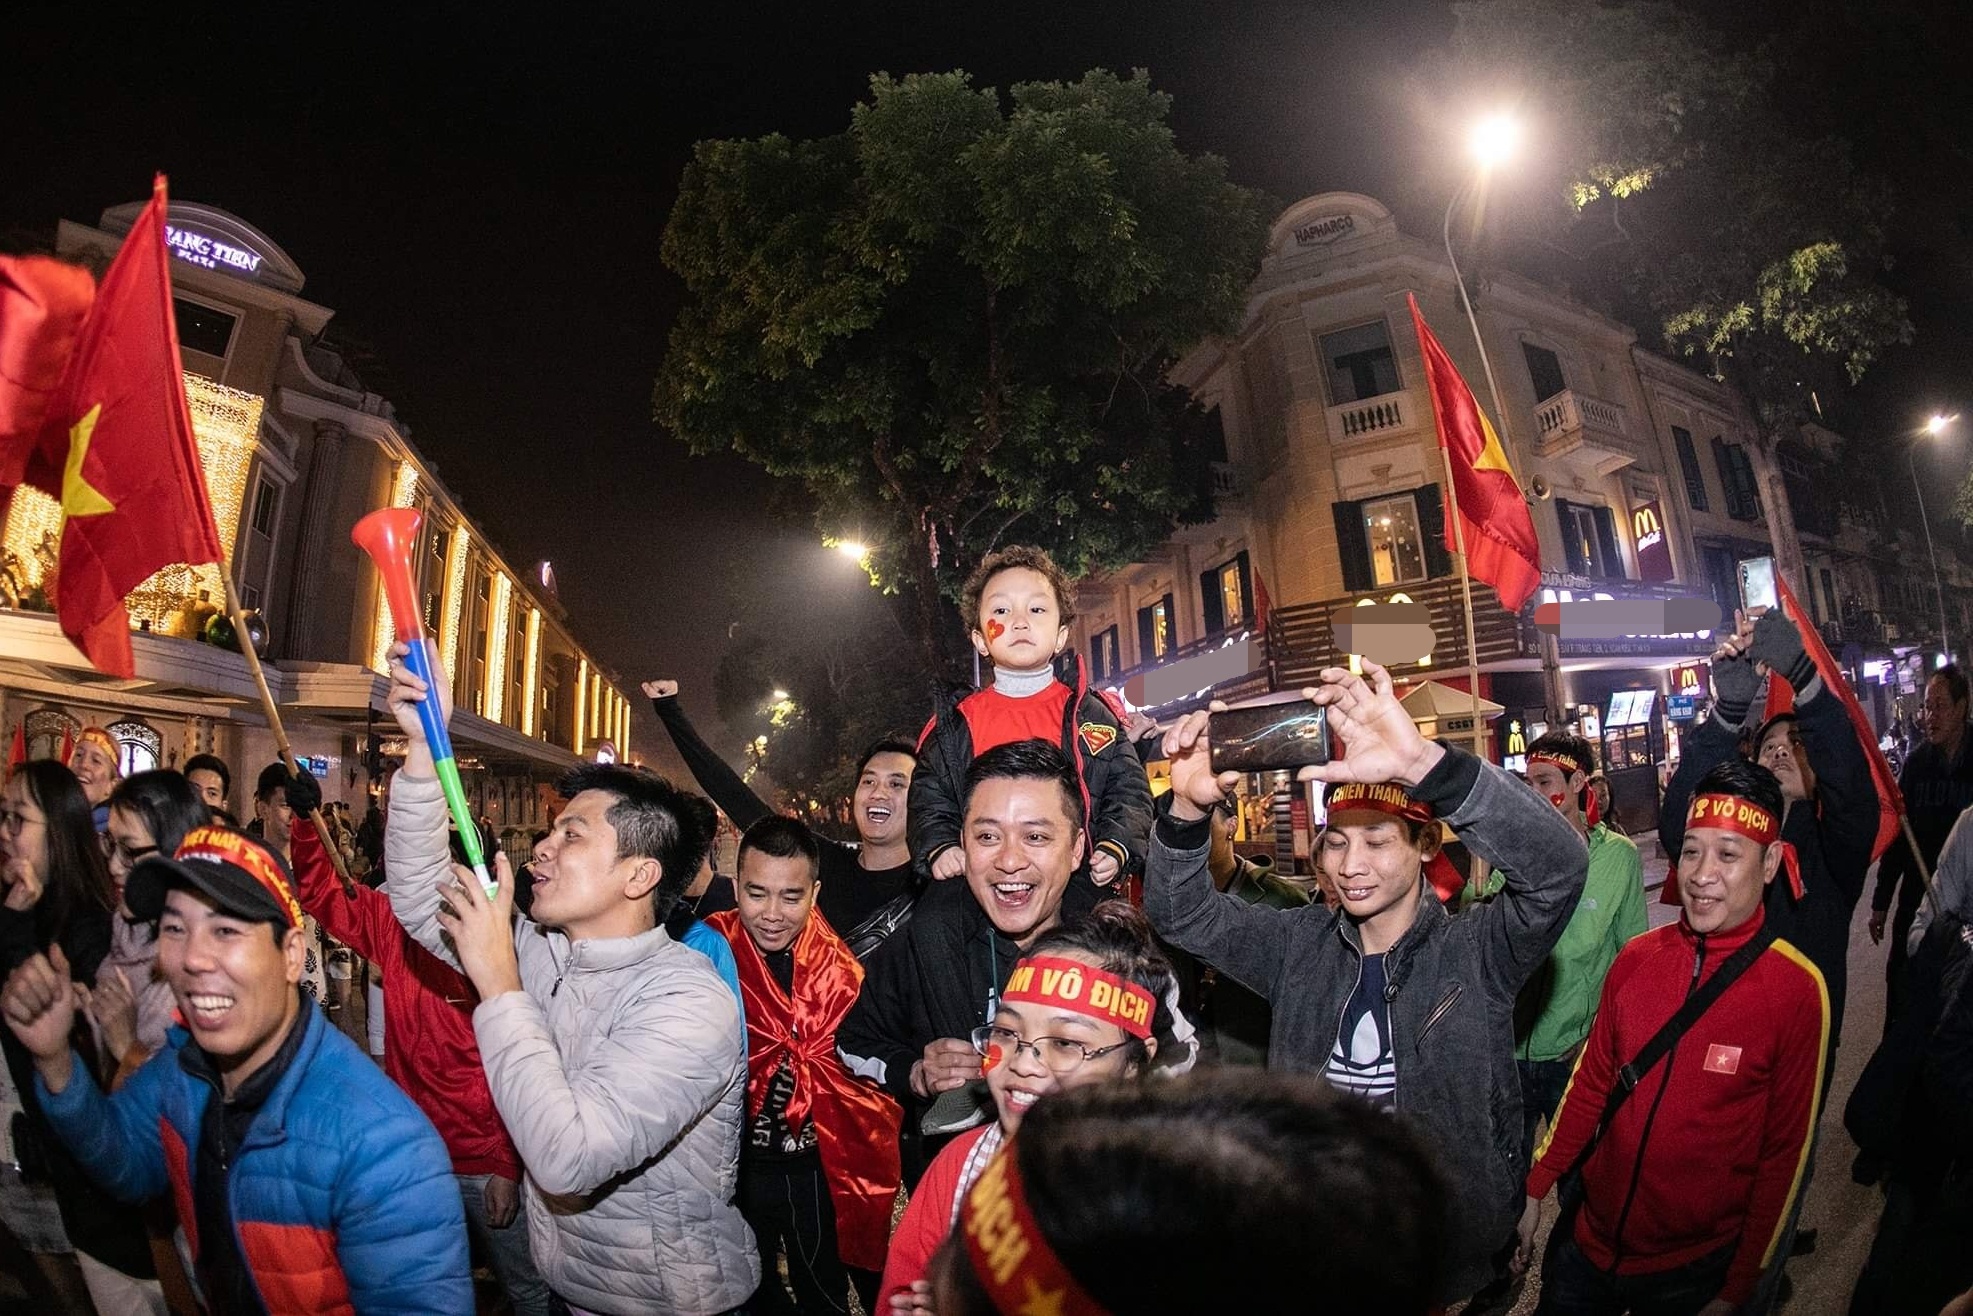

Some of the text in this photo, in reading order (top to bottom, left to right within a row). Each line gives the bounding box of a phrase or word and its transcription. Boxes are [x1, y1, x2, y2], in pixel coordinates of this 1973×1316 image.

[1294, 215, 1353, 243] HAPHARCO
[1713, 796, 1770, 833] VÔ ĐỊCH
[1041, 967, 1084, 1000] VÔ
[1089, 980, 1150, 1027] ĐỊCH
